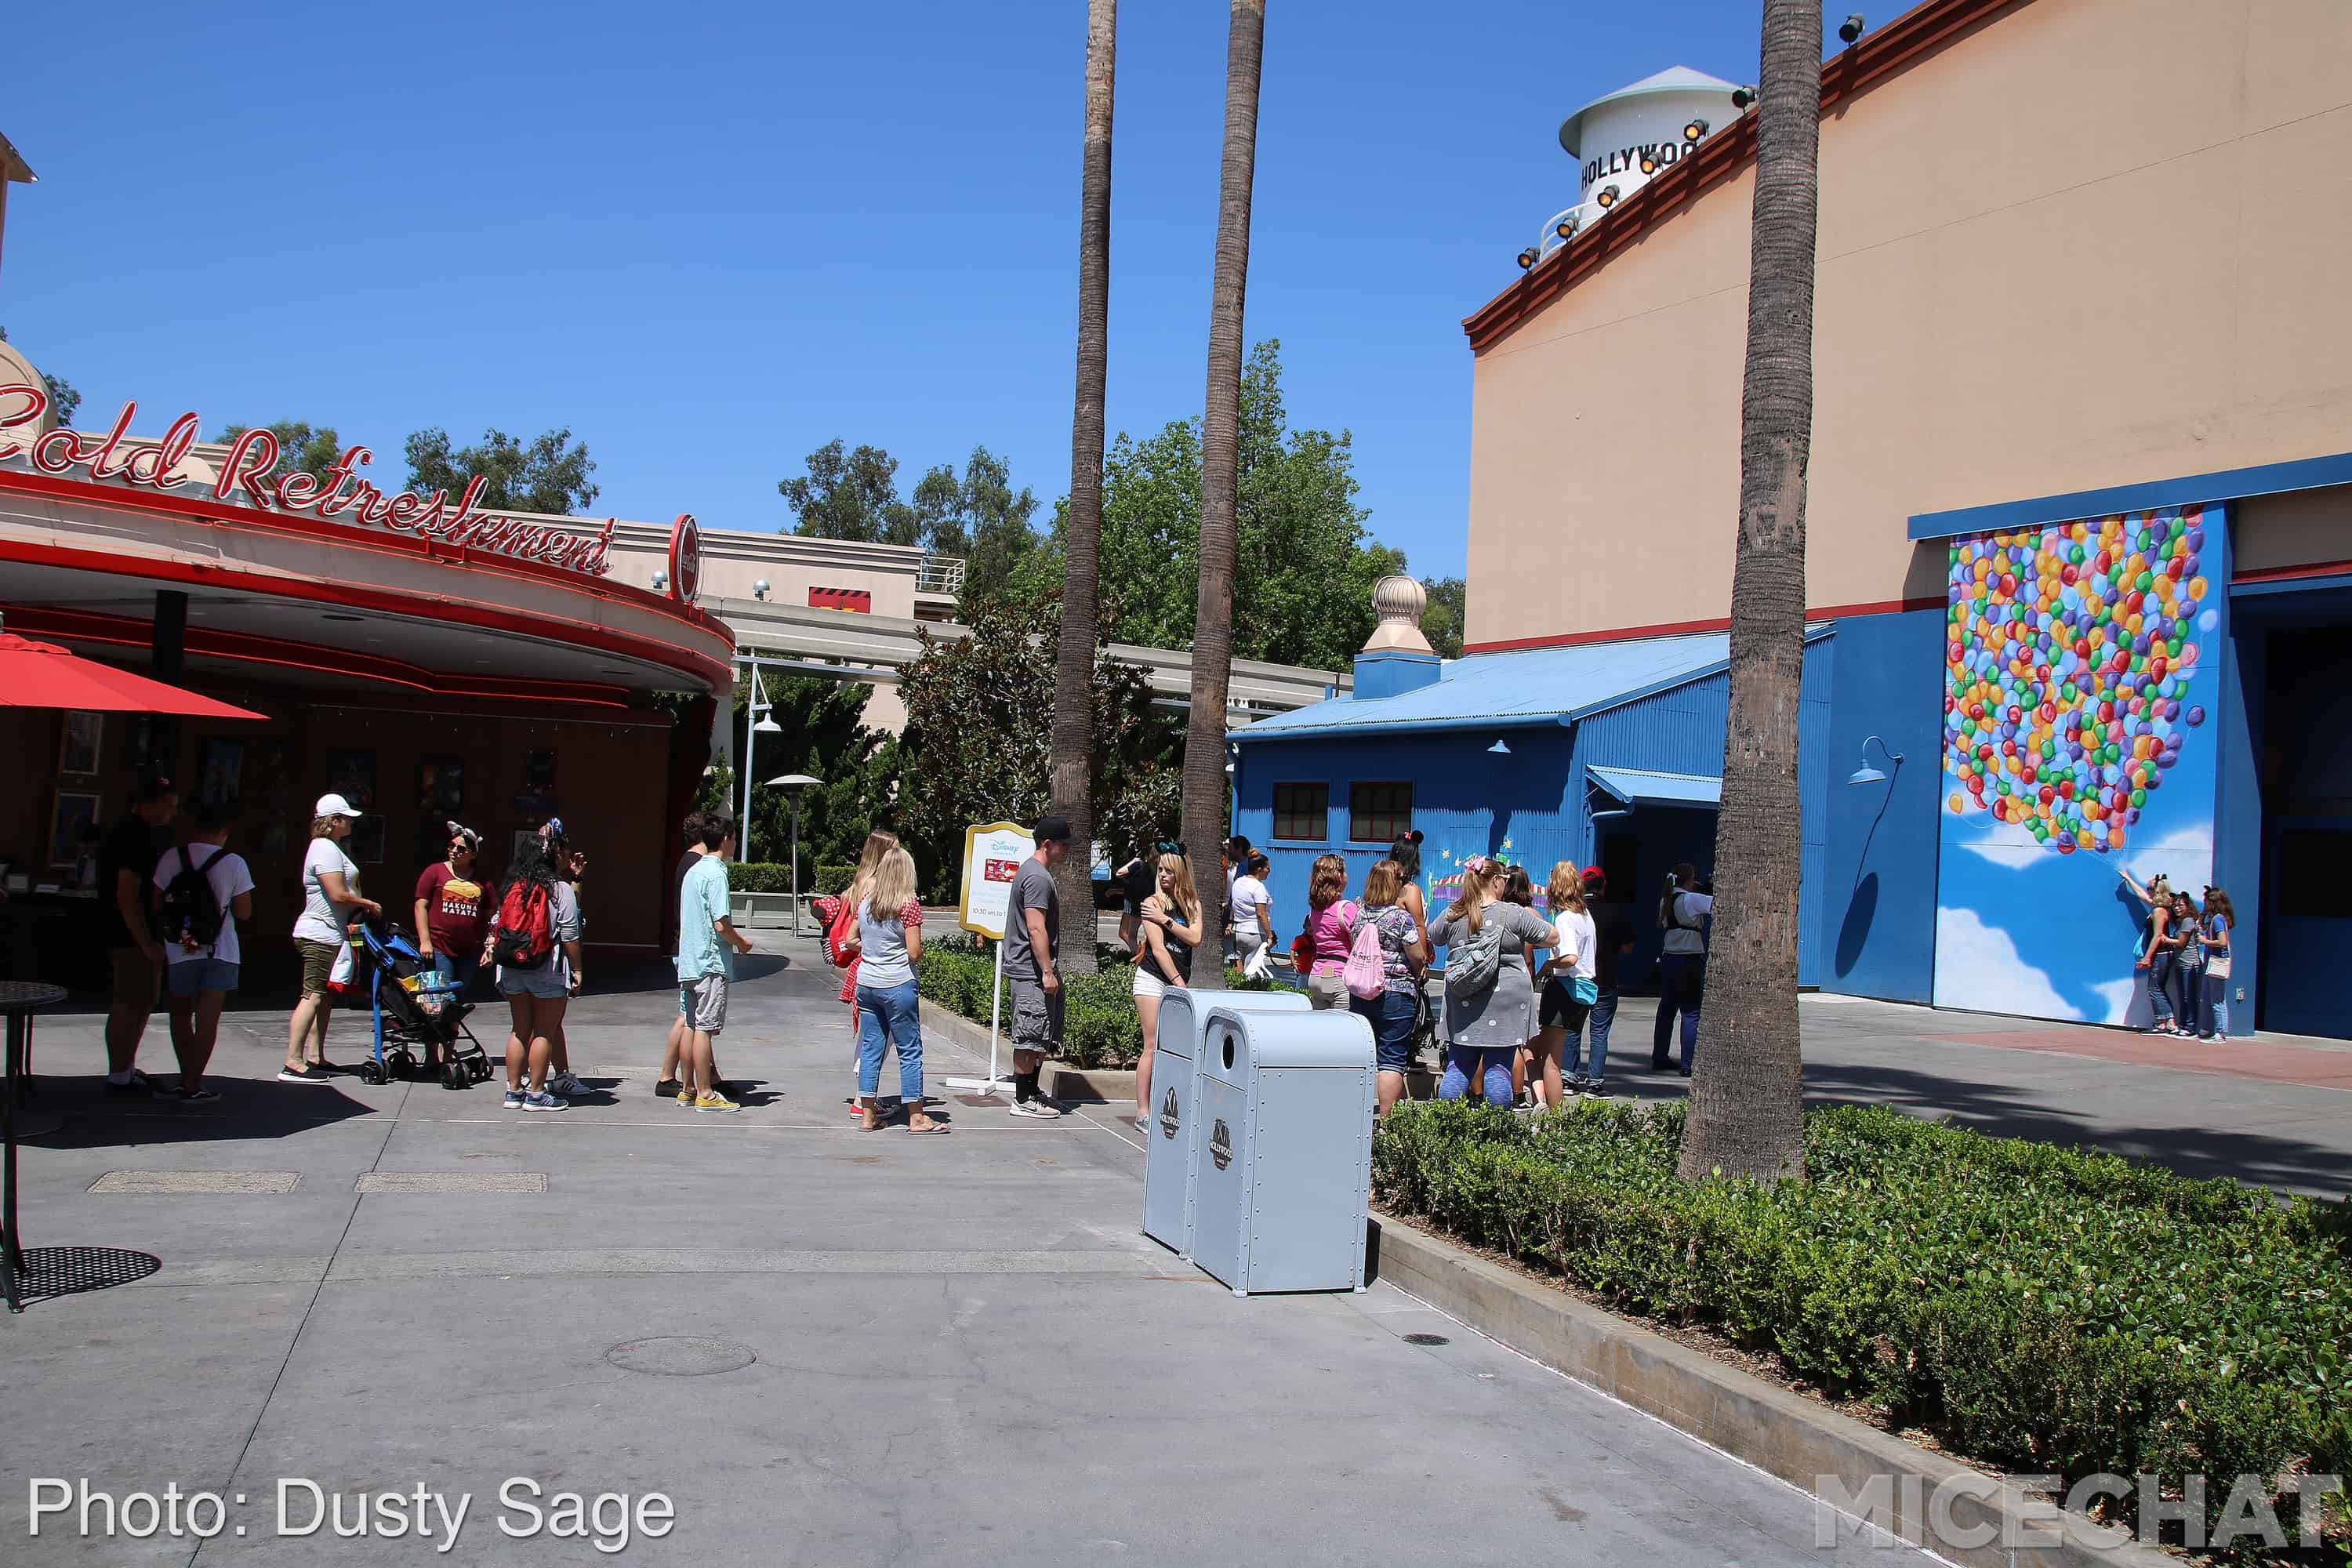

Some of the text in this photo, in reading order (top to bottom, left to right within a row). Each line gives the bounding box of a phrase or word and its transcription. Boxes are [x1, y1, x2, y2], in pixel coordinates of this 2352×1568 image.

[213, 428, 619, 575] Refreshment
[989, 839, 1020, 855] Disney
[442, 902, 477, 912] HAKUNA
[442, 908, 477, 917] MATATA
